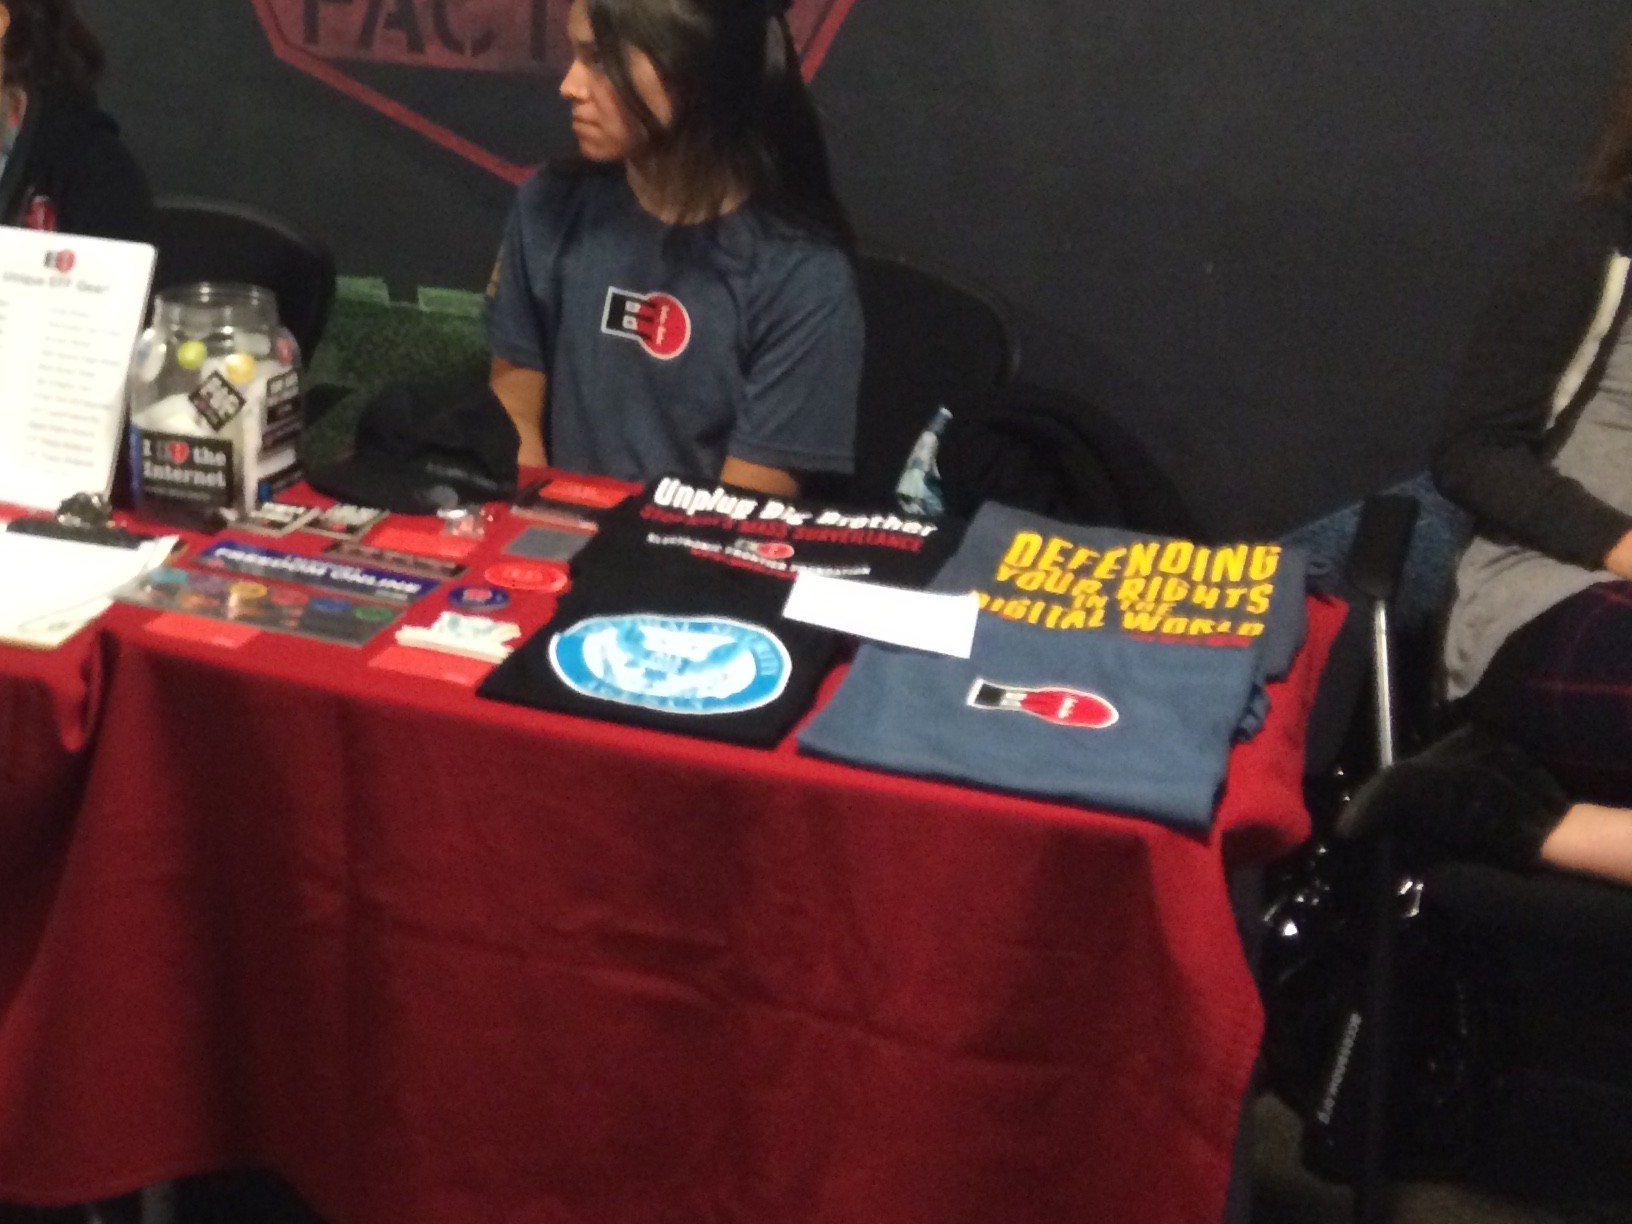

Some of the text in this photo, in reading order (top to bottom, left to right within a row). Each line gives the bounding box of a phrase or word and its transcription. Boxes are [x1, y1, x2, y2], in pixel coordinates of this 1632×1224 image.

[143, 460, 227, 487] Internet
[193, 446, 227, 466] the
[653, 476, 758, 520] Unplug
[759, 500, 813, 526] Big
[815, 511, 939, 537] Brother
[1002, 531, 1282, 582] DEFENDING
[996, 565, 1275, 614] YOUR RIGHTS
[1121, 611, 1266, 637] WORLD
